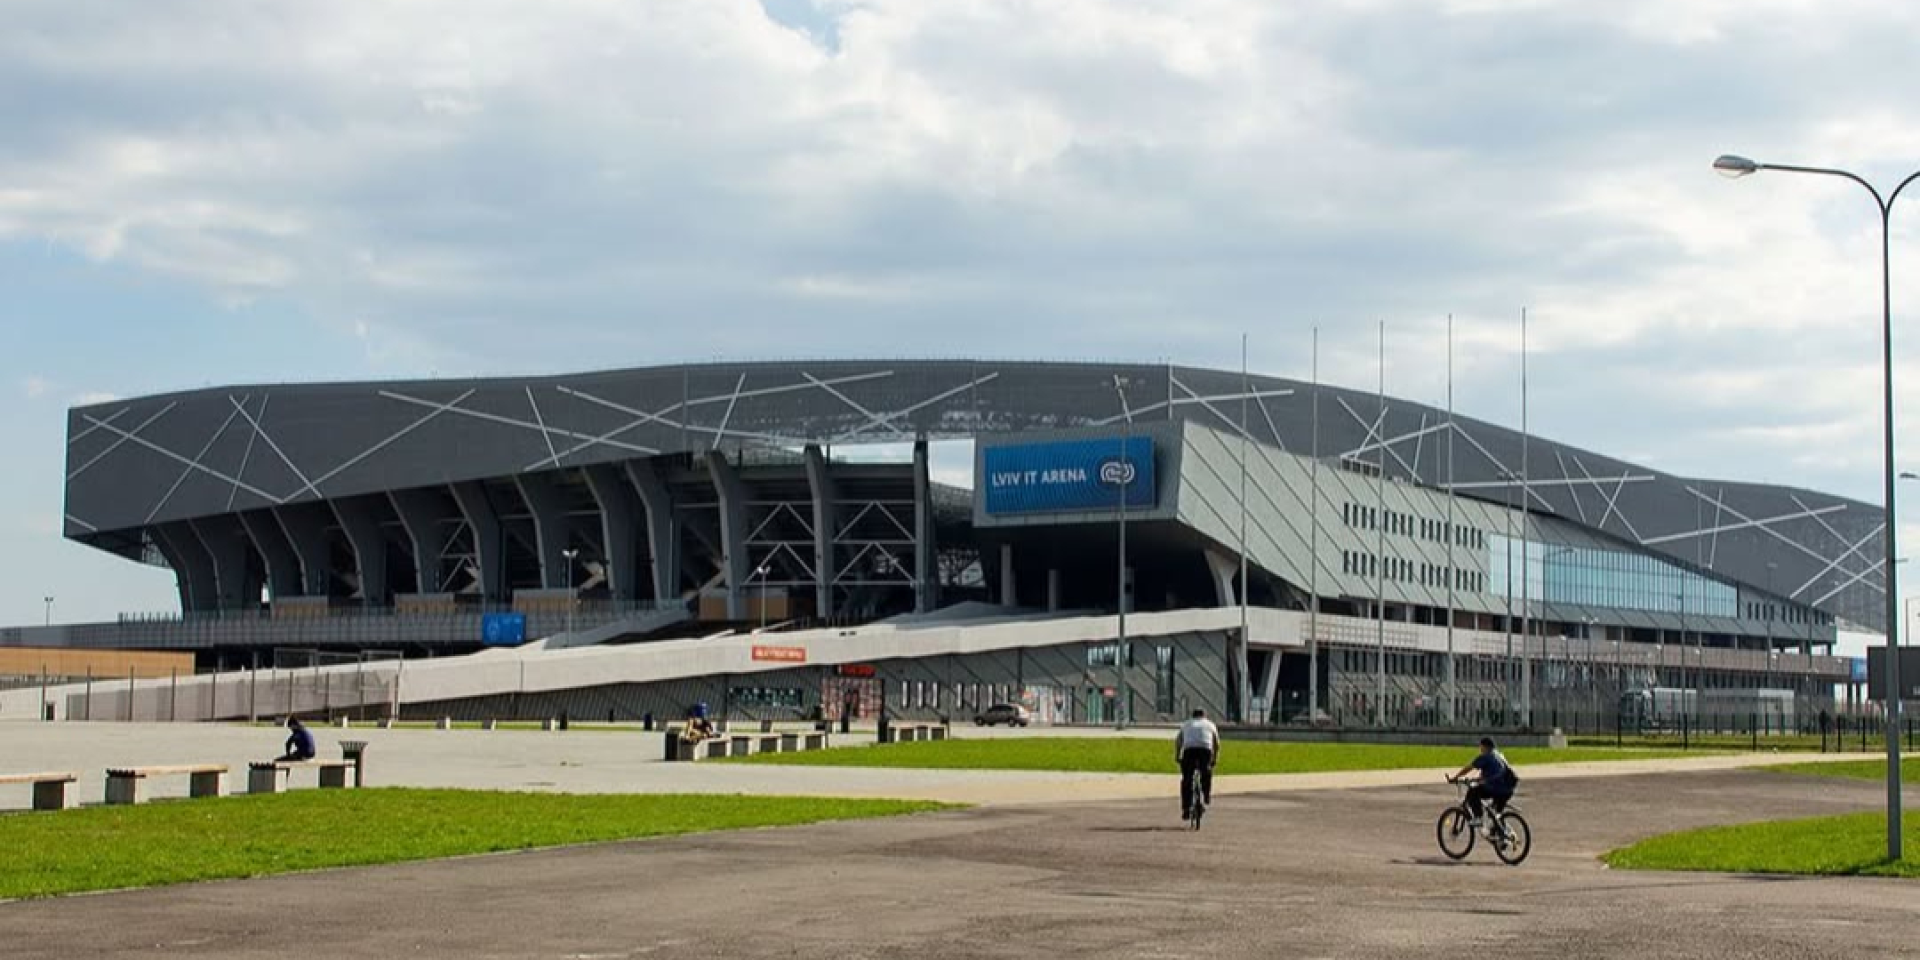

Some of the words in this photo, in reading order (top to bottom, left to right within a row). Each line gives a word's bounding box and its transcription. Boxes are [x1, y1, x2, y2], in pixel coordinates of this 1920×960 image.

[991, 472, 1020, 487] LVIV
[1024, 471, 1037, 485] IT
[1041, 469, 1087, 483] ARENA
